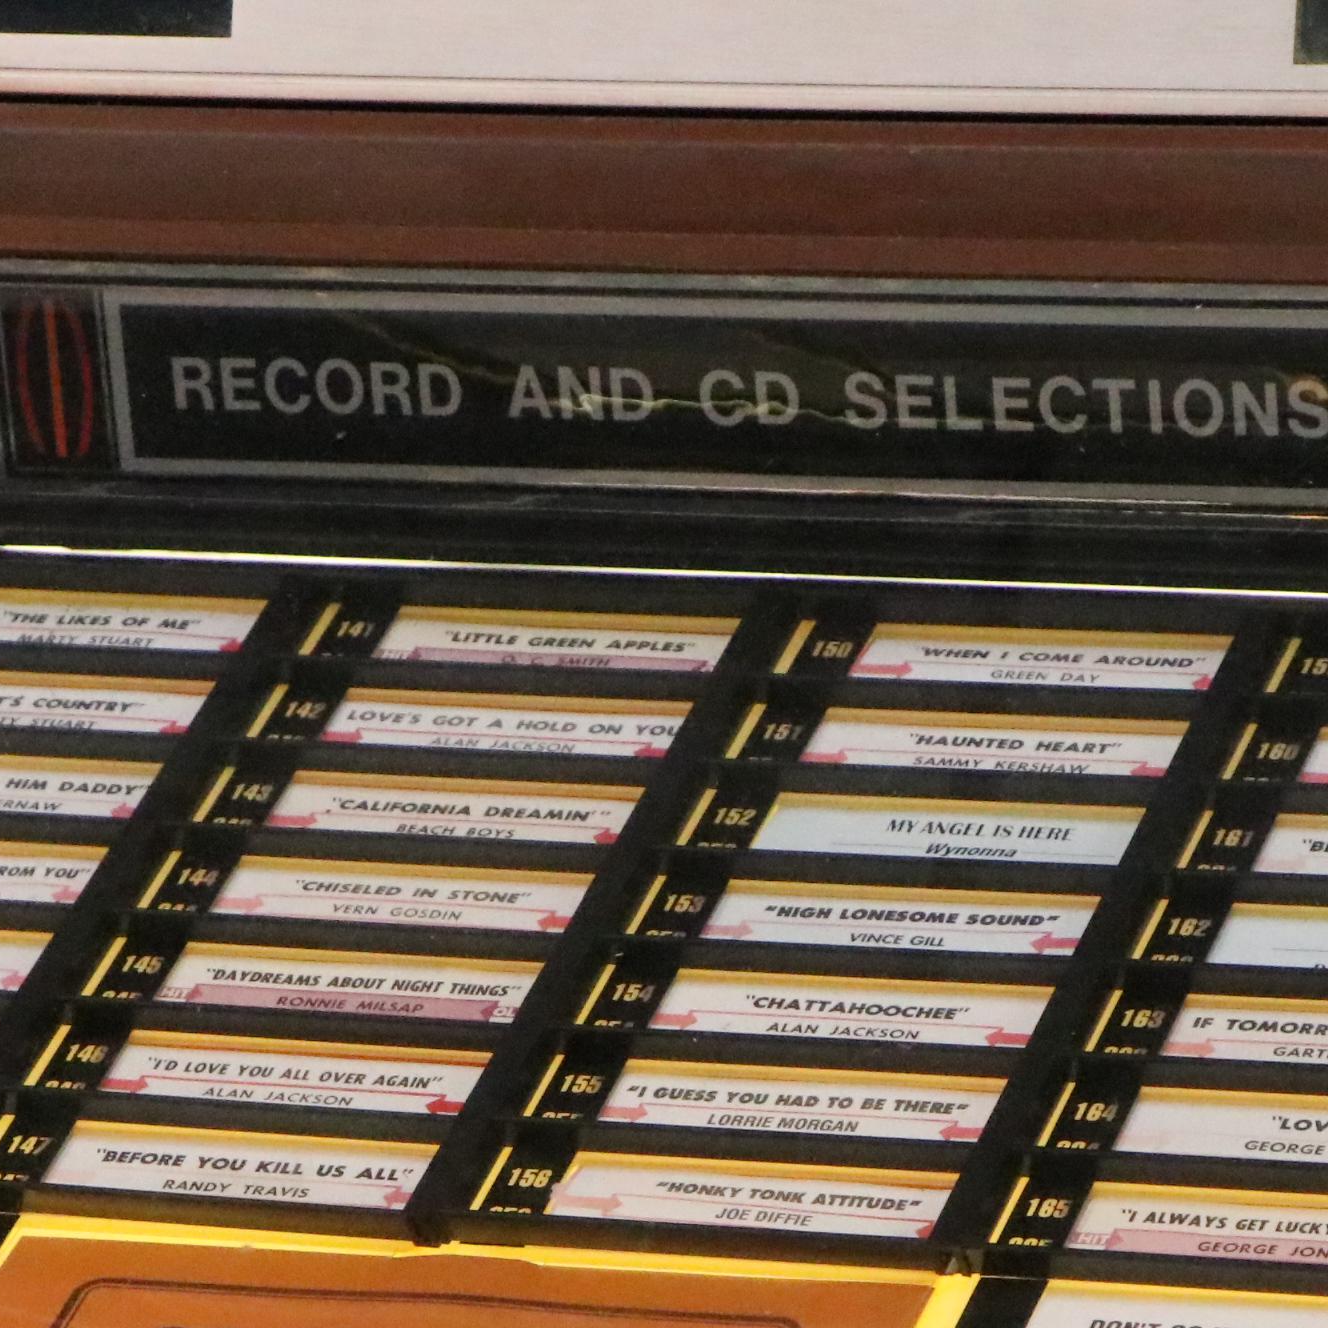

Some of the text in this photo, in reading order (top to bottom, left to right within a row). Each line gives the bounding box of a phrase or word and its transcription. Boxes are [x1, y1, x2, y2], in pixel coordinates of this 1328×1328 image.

[170, 357, 462, 420] RECORD
[510, 365, 651, 423] AND
[699, 371, 801, 427] CD
[5, 611, 200, 631] "THE LIKES OF ME"
[910, 733, 1121, 755] "HAUNTED HEART"
[296, 879, 532, 905] "CHISELED IN STONE"
[334, 904, 463, 922] VERN GOSDIN
[746, 995, 970, 1022] "CHATTAHOOCHEE"
[768, 1022, 920, 1040] ALAN JACKSON
[562, 1075, 603, 1093] 155
[1245, 1140, 1328, 1157] GEORGE
[98, 1147, 414, 1182] "BEFORE YOU KILL US ALL"
[164, 1179, 310, 1199] RANDY TRAVIS
